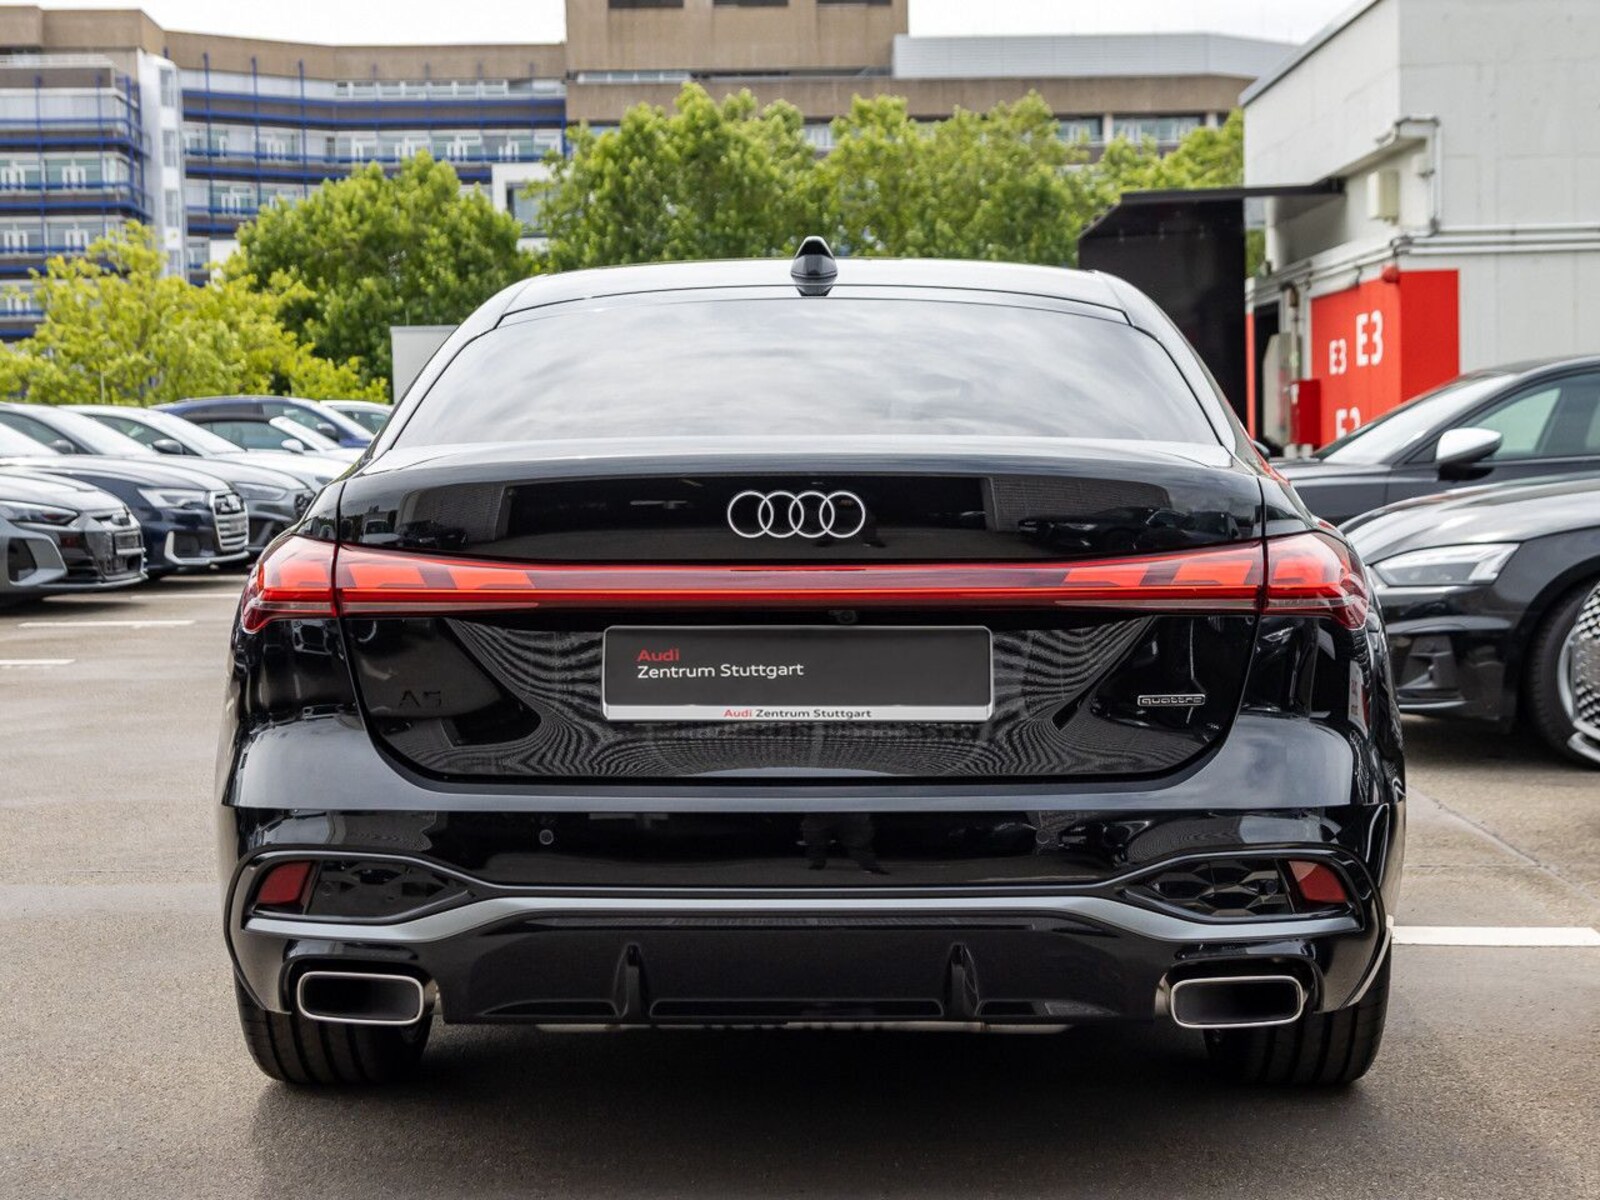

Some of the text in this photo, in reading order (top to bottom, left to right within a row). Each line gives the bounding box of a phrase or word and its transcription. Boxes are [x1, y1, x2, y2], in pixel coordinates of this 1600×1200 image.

[1355, 310, 1384, 367] E3
[1328, 338, 1347, 375] E3
[636, 649, 680, 662] Audi
[637, 663, 804, 679] Zentrum Stuttgart
[1141, 697, 1203, 705] quattro
[723, 708, 872, 719] Audi Zentrum Stuttgart
